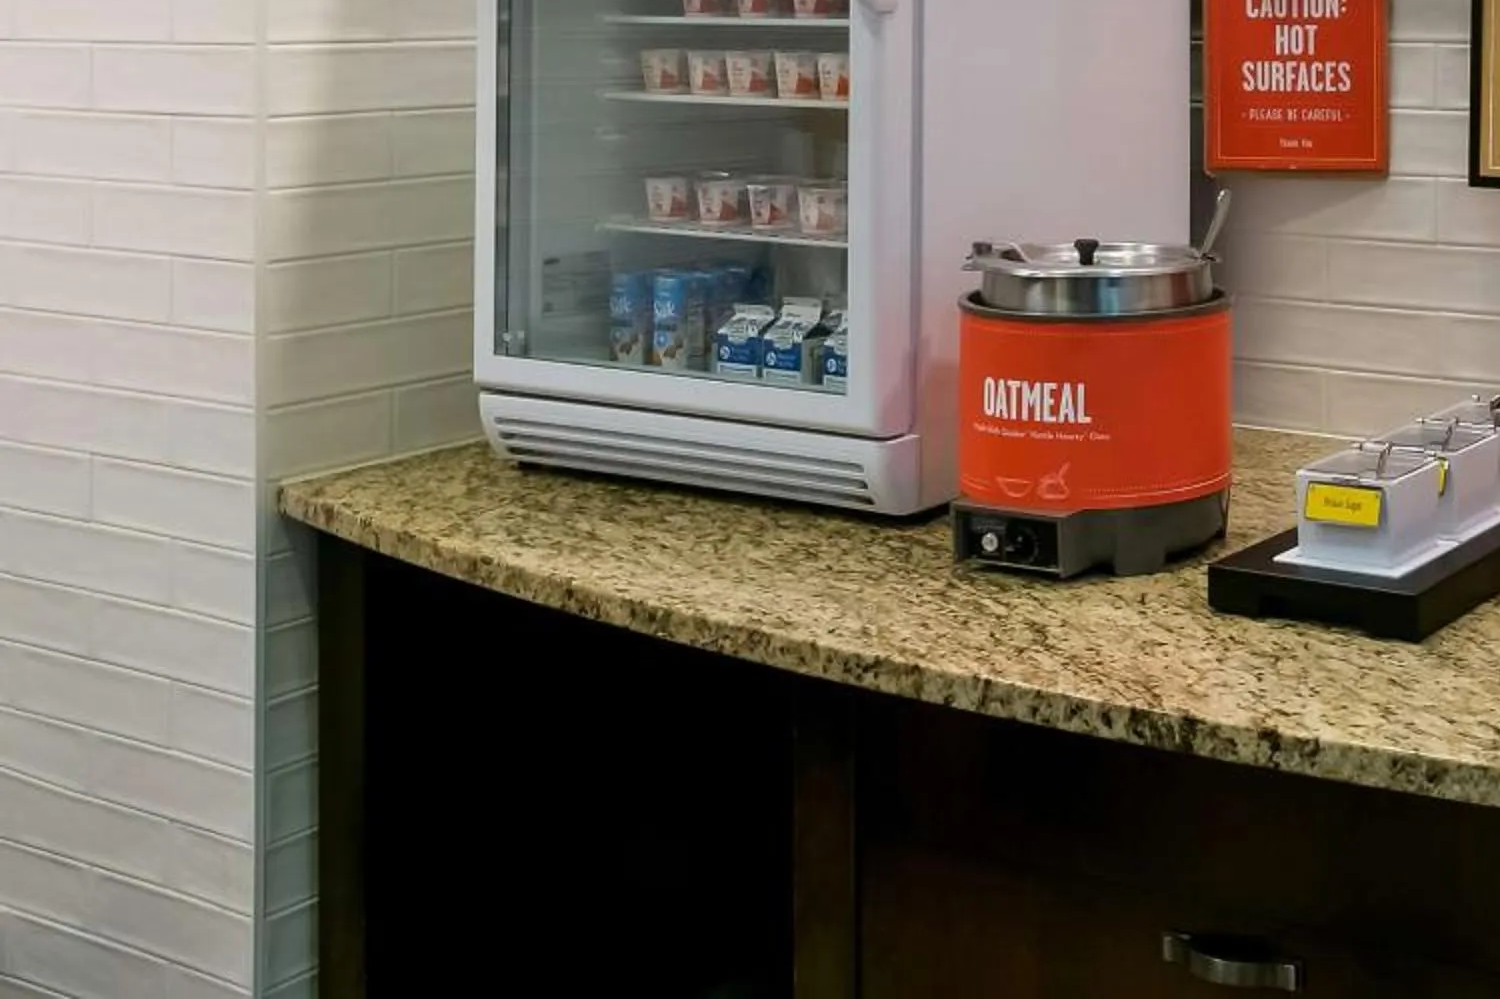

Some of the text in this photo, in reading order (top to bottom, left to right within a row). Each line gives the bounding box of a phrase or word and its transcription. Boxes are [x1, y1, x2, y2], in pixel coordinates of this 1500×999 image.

[1275, 24, 1318, 57] HOT
[1242, 61, 1351, 93] SURFACES
[1249, 108, 1283, 122] PLEASE
[1301, 108, 1343, 122] CAREFUL
[983, 375, 1093, 424] OATMEAL
